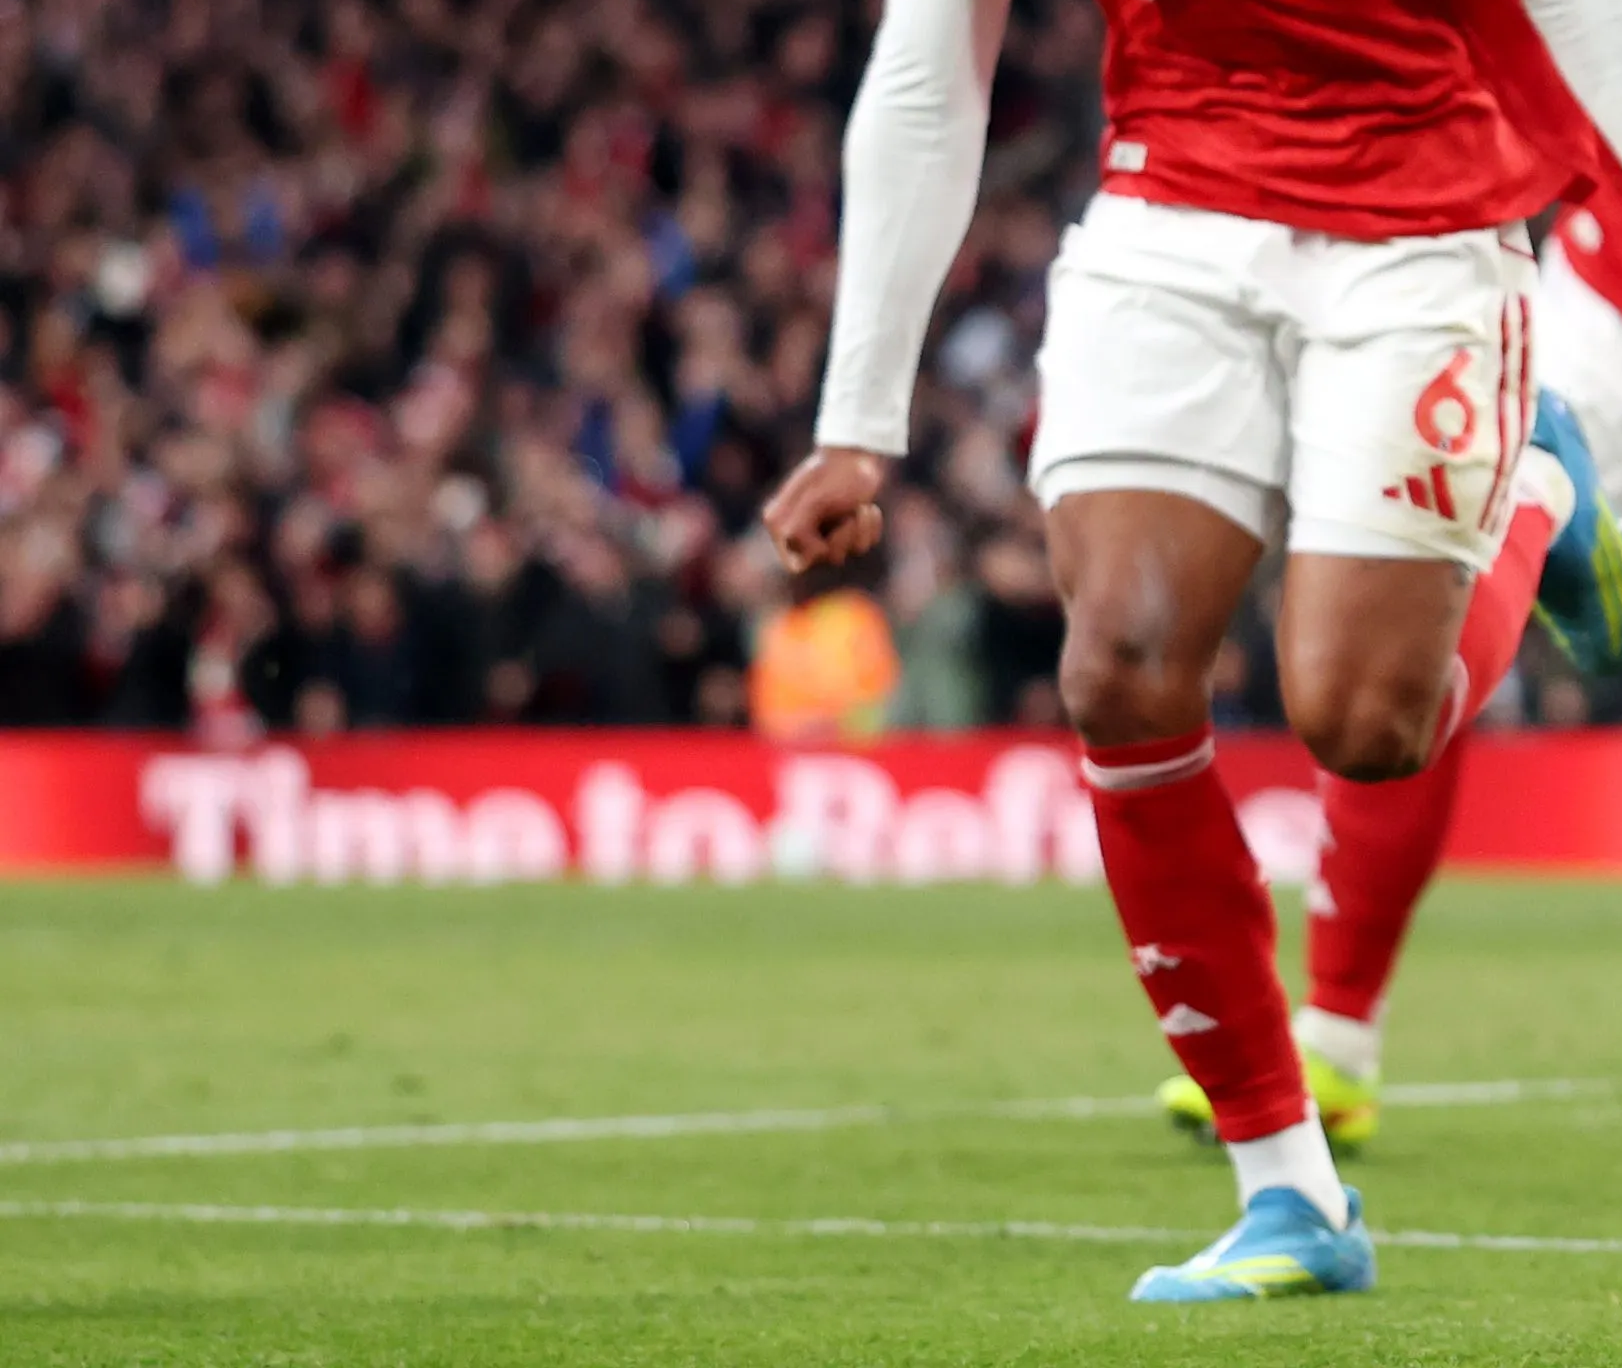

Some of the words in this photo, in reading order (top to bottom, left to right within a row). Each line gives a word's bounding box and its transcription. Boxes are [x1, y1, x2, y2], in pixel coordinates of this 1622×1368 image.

[1414, 349, 1476, 455] 6
[138, 744, 568, 887] Time
[576, 759, 762, 887] to
